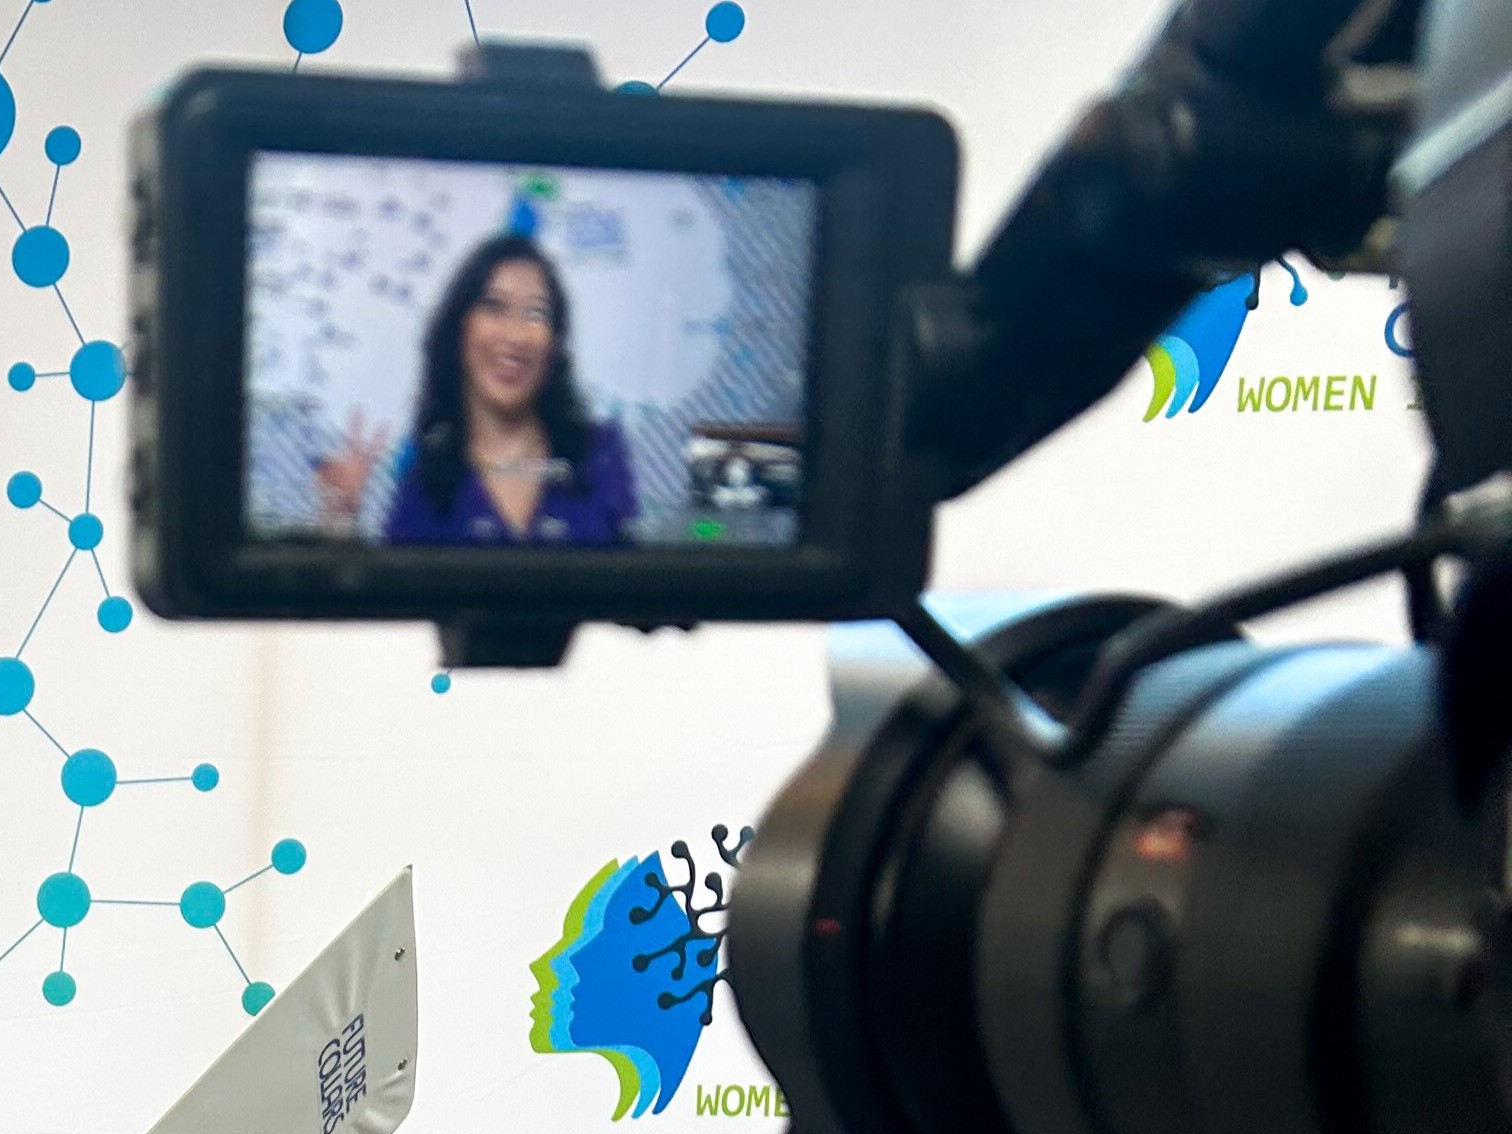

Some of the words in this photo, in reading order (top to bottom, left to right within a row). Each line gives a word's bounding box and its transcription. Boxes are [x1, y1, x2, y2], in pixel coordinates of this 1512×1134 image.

[1237, 374, 1377, 413] WOMEN
[342, 1012, 367, 1113] FUTURE
[695, 1084, 792, 1117] WOME
